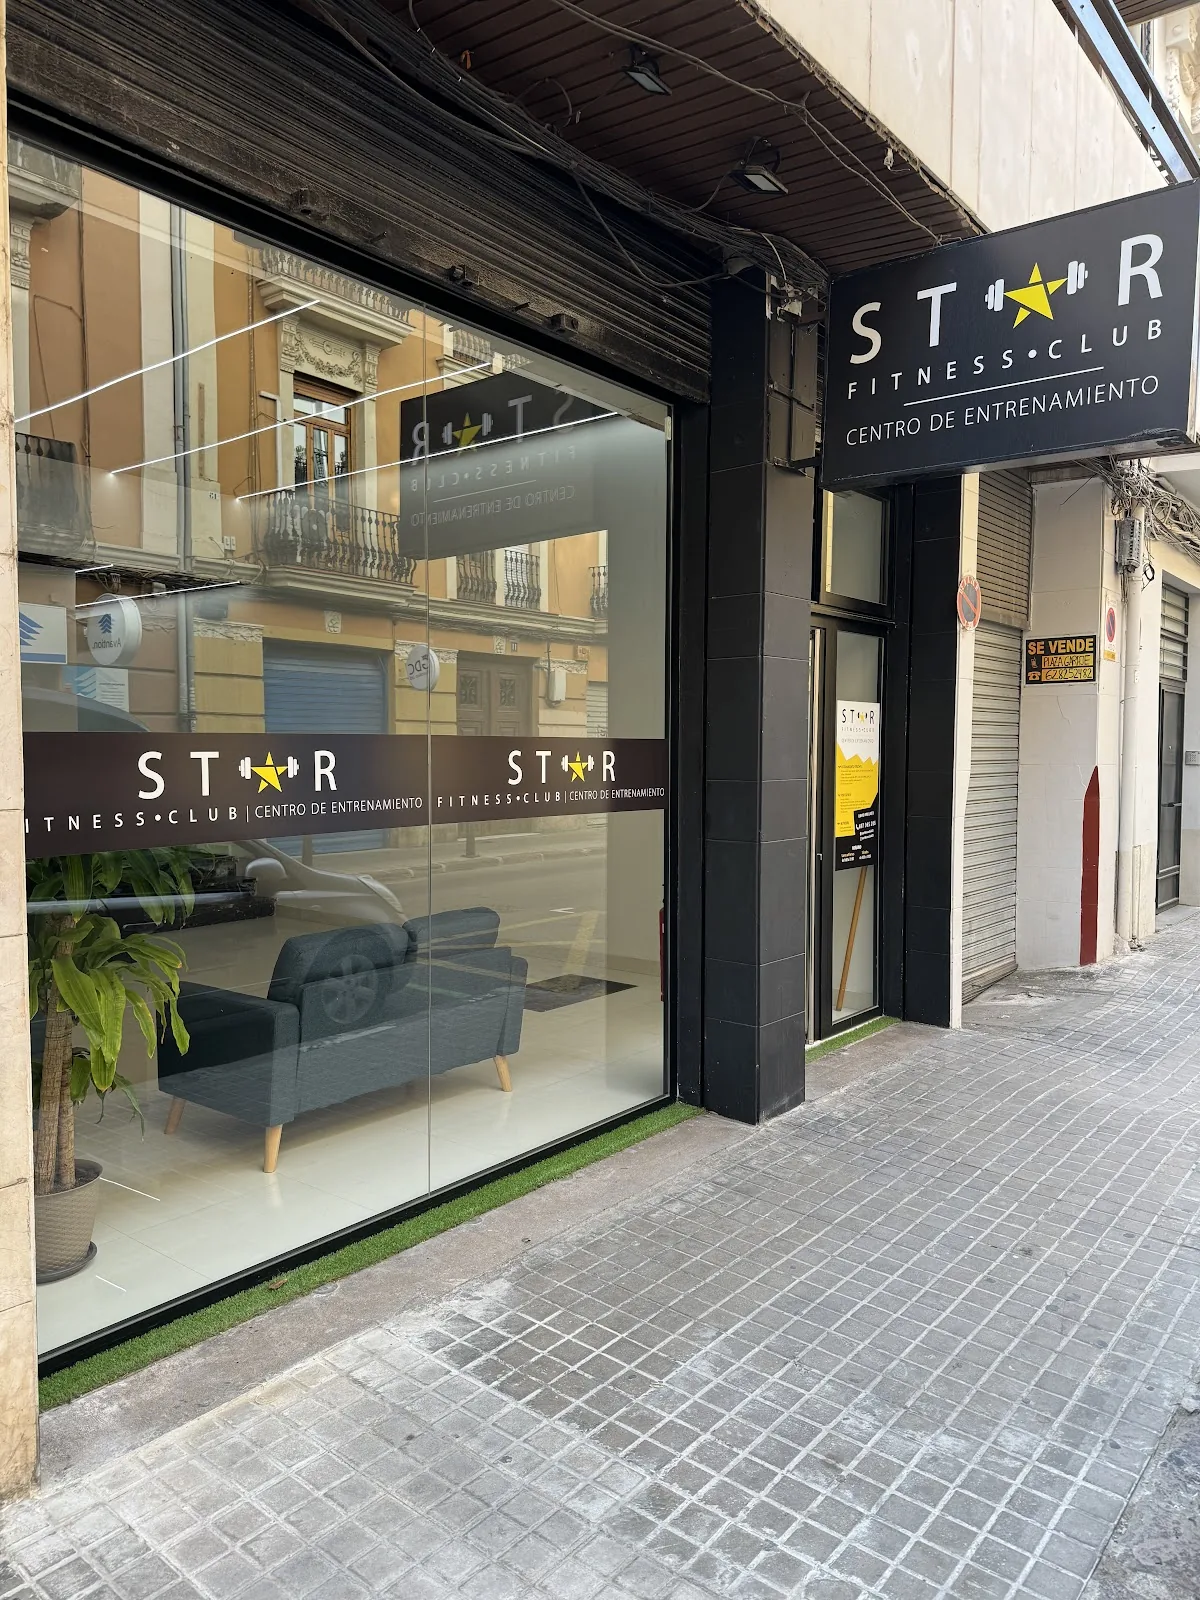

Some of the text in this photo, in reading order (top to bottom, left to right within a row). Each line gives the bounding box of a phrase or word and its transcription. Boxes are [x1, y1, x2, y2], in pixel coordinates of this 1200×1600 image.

[846, 375, 1159, 446] CENTRO DE ENTRENAMIENTO
[1027, 641, 1045, 655] SE
[1048, 637, 1094, 654] VENDE
[569, 790, 598, 801] CENTRO
[599, 789, 610, 800] DE
[611, 787, 665, 799] ENTRENAMIENTO
[25, 811, 146, 834] ITNESS
[254, 802, 306, 819] CENTRO
[310, 802, 327, 815] DE
[331, 796, 423, 814] ENTRENAMIENTO
